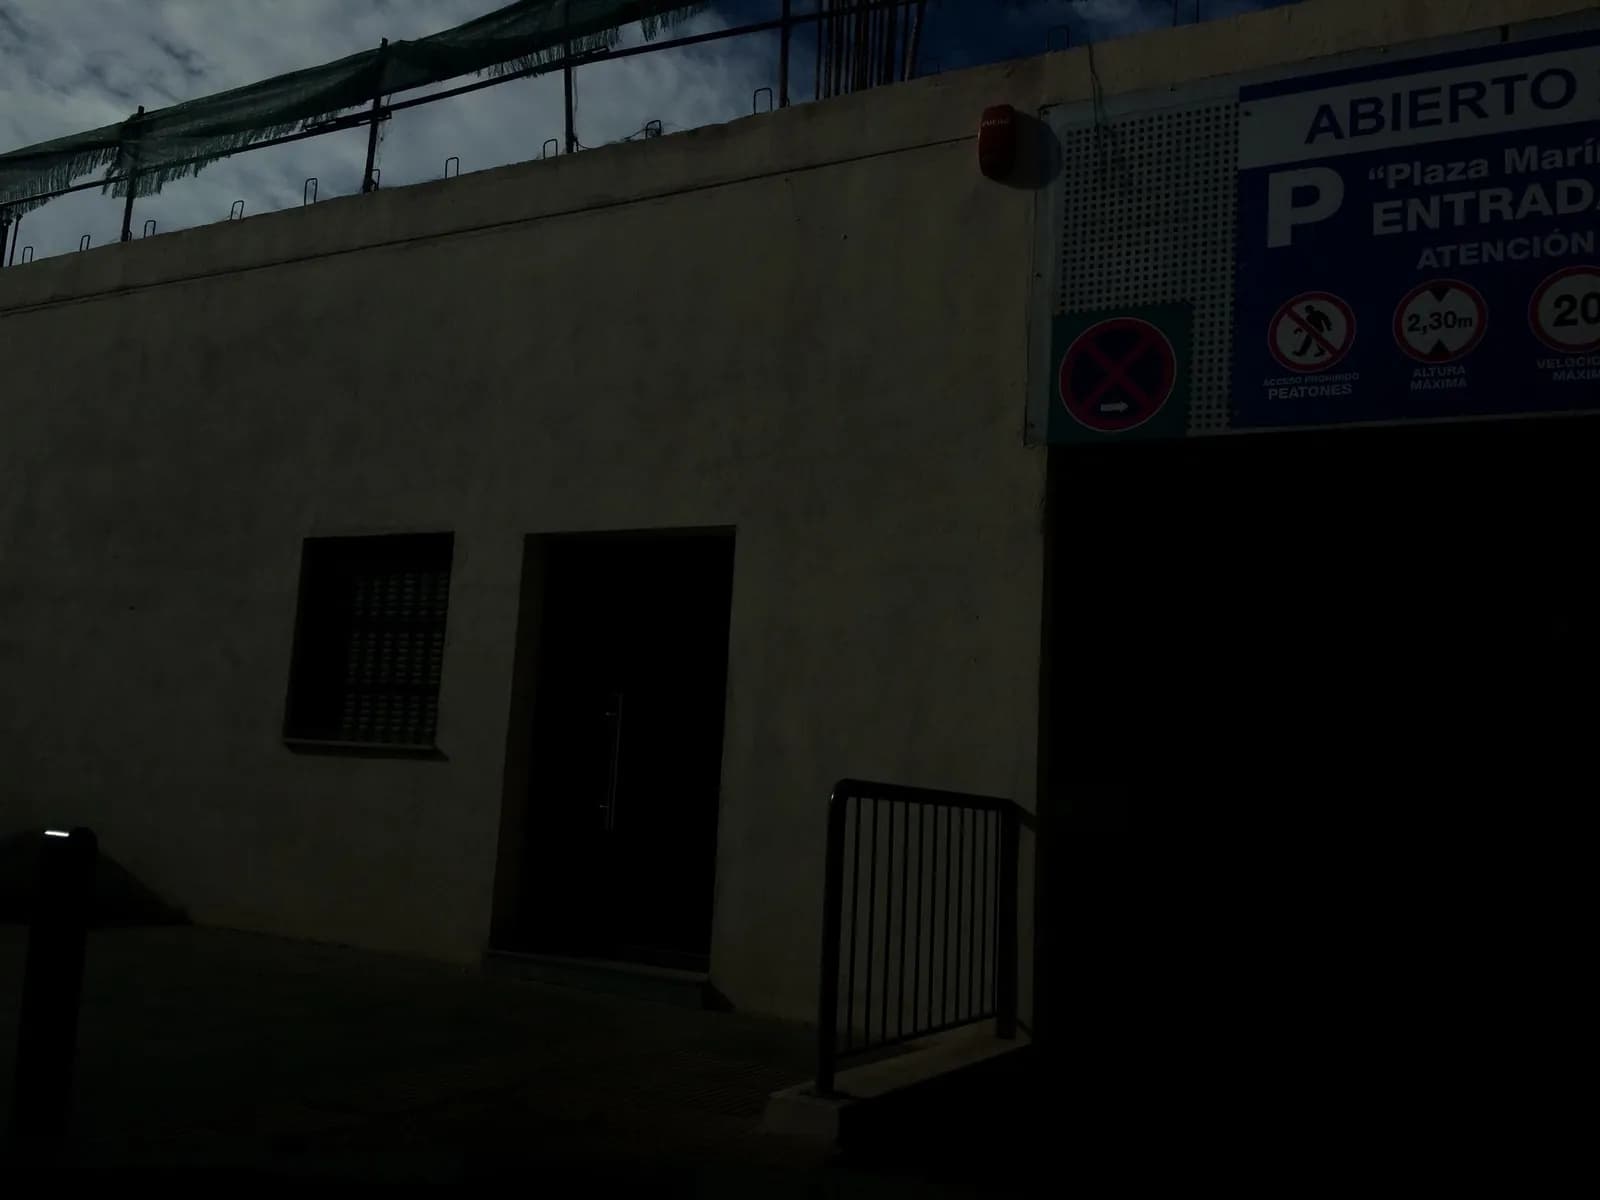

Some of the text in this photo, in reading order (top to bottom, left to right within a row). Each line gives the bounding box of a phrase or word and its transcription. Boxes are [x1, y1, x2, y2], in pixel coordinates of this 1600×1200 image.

[1304, 68, 1577, 145] ABIERTO
[1503, 136, 1600, 176] Marí
[1266, 165, 1346, 250] P
[1371, 177, 1600, 237] ENTRAD
[1415, 227, 1595, 271] ATENCIÓN
[1407, 310, 1473, 335] 2,30m
[1552, 291, 1600, 328] 20
[1412, 364, 1466, 378] ALTURA
[1267, 383, 1353, 401] PEATONES
